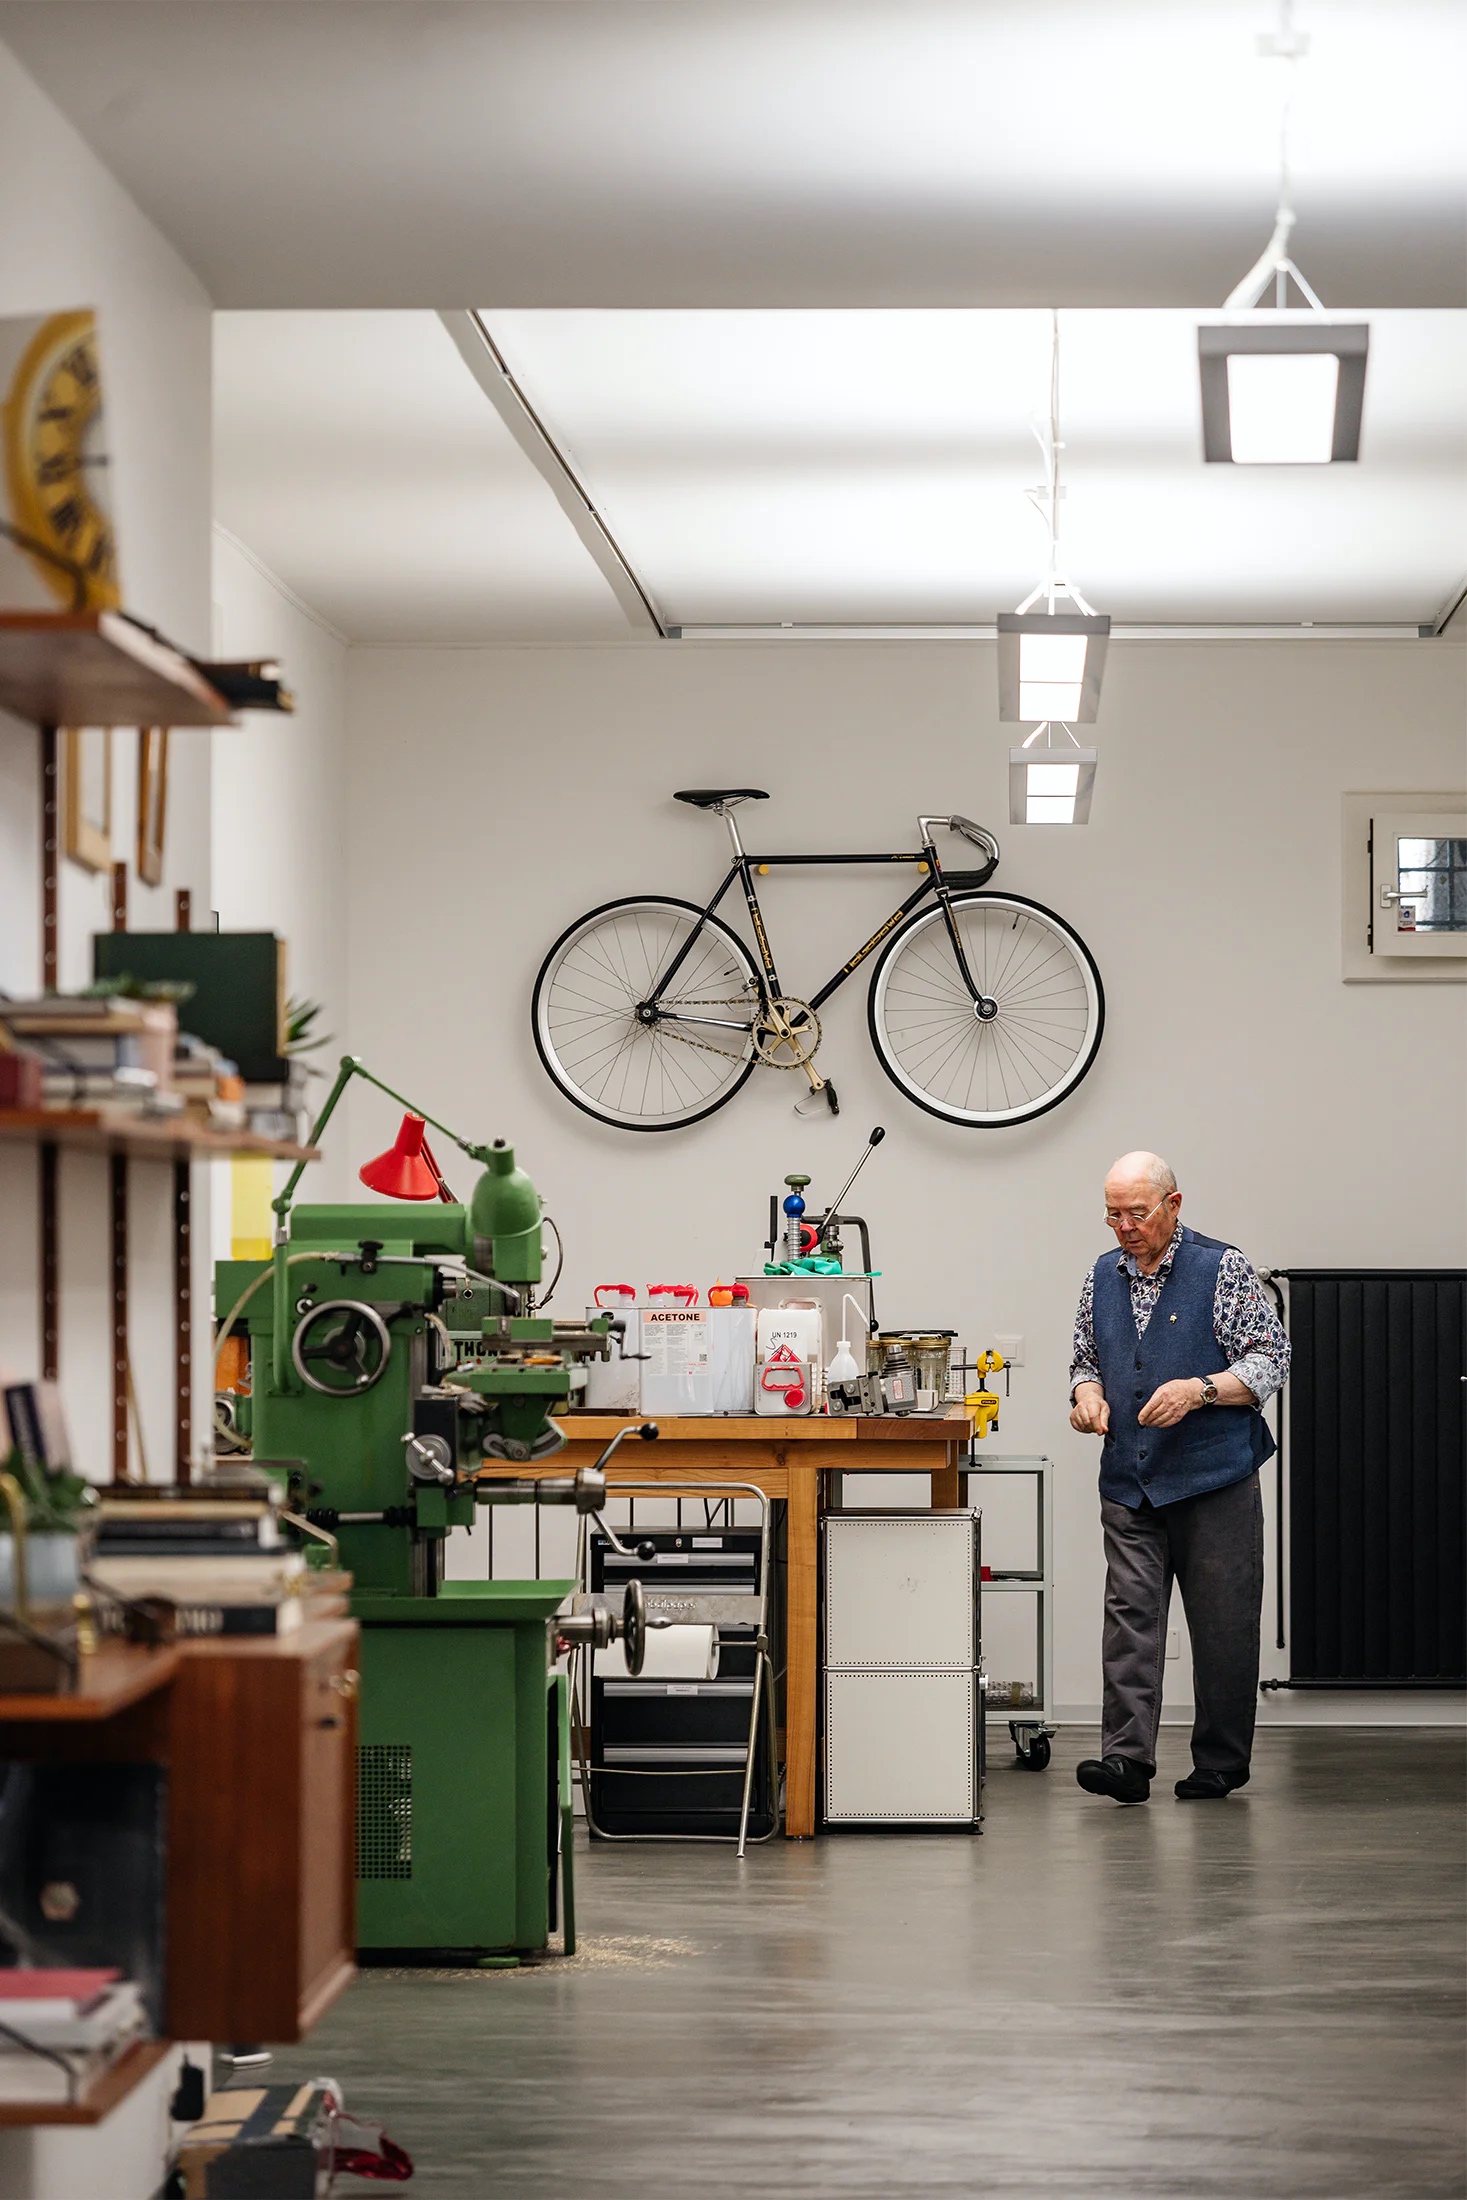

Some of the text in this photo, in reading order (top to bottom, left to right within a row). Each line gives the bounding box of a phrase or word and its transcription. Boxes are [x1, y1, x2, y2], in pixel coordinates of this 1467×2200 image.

[651, 1313, 700, 1321] ACETONE
[771, 1331, 798, 1339] UN 1219
